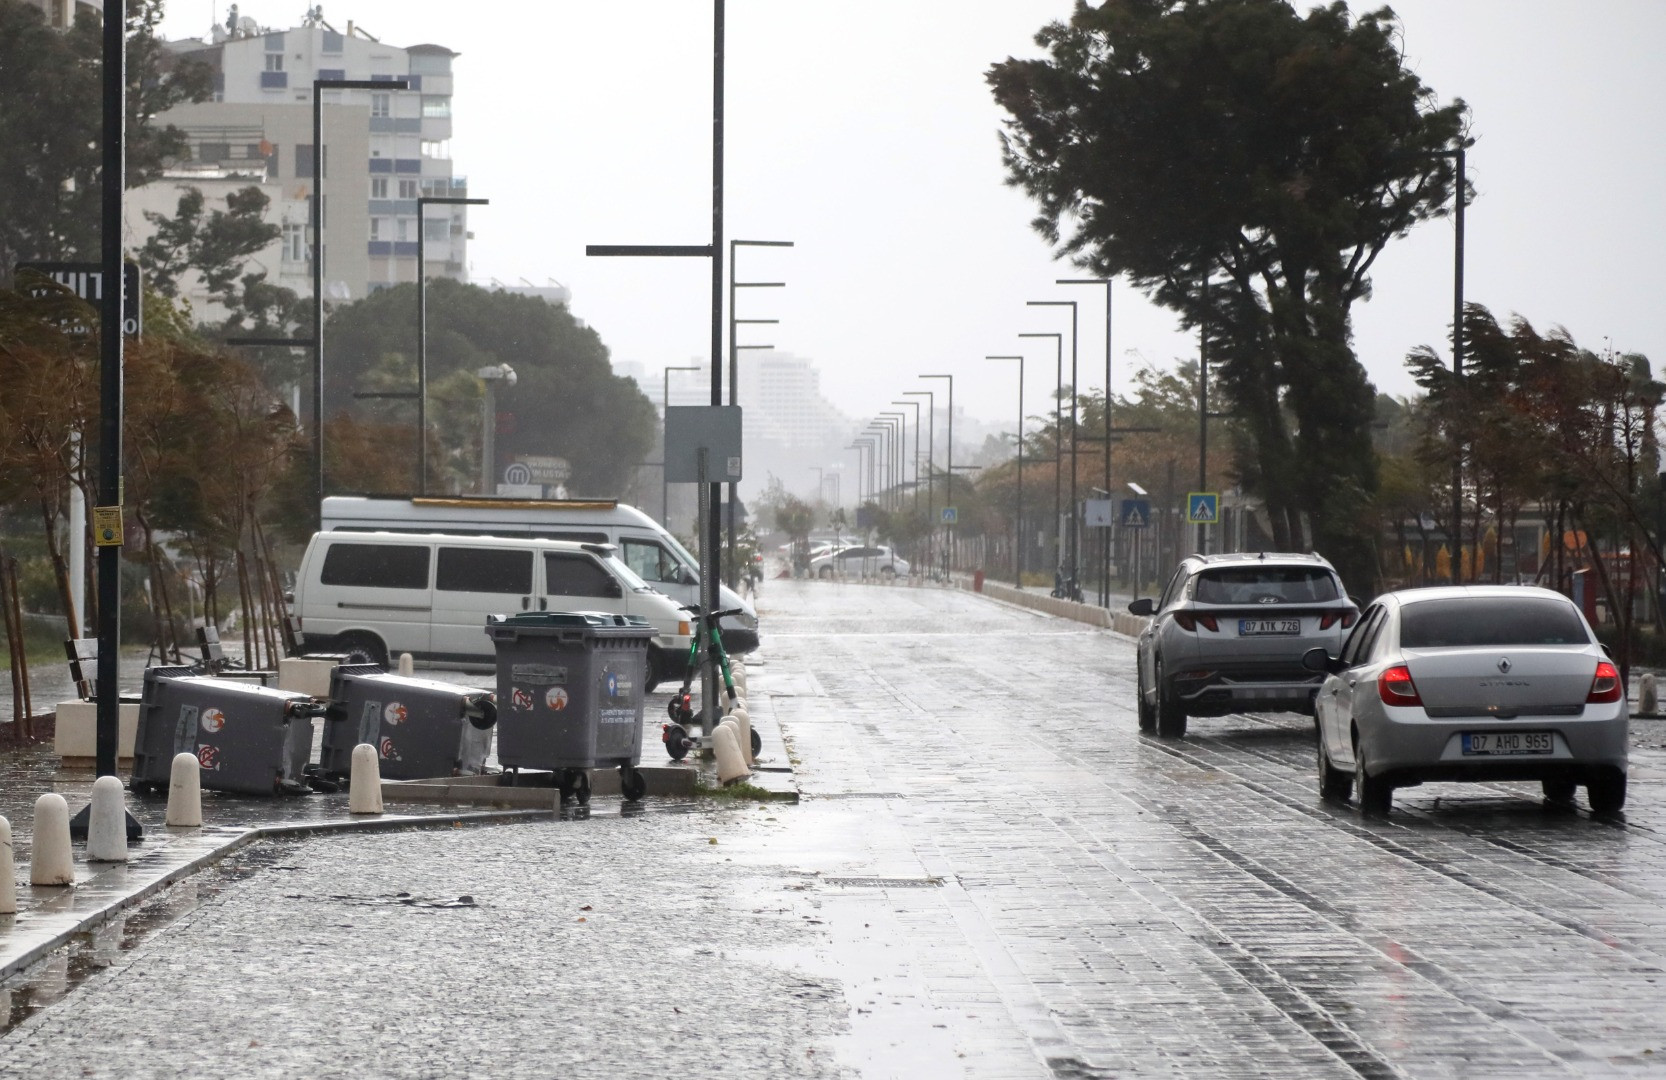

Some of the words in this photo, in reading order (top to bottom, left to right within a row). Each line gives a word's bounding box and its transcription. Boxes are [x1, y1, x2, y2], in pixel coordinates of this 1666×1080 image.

[1245, 621, 1257, 631] 07
[1260, 621, 1277, 631] ATK
[1281, 621, 1299, 631] 726
[1472, 735, 1488, 750] 07
[1496, 735, 1520, 750] AHD
[1525, 734, 1549, 749] 965
